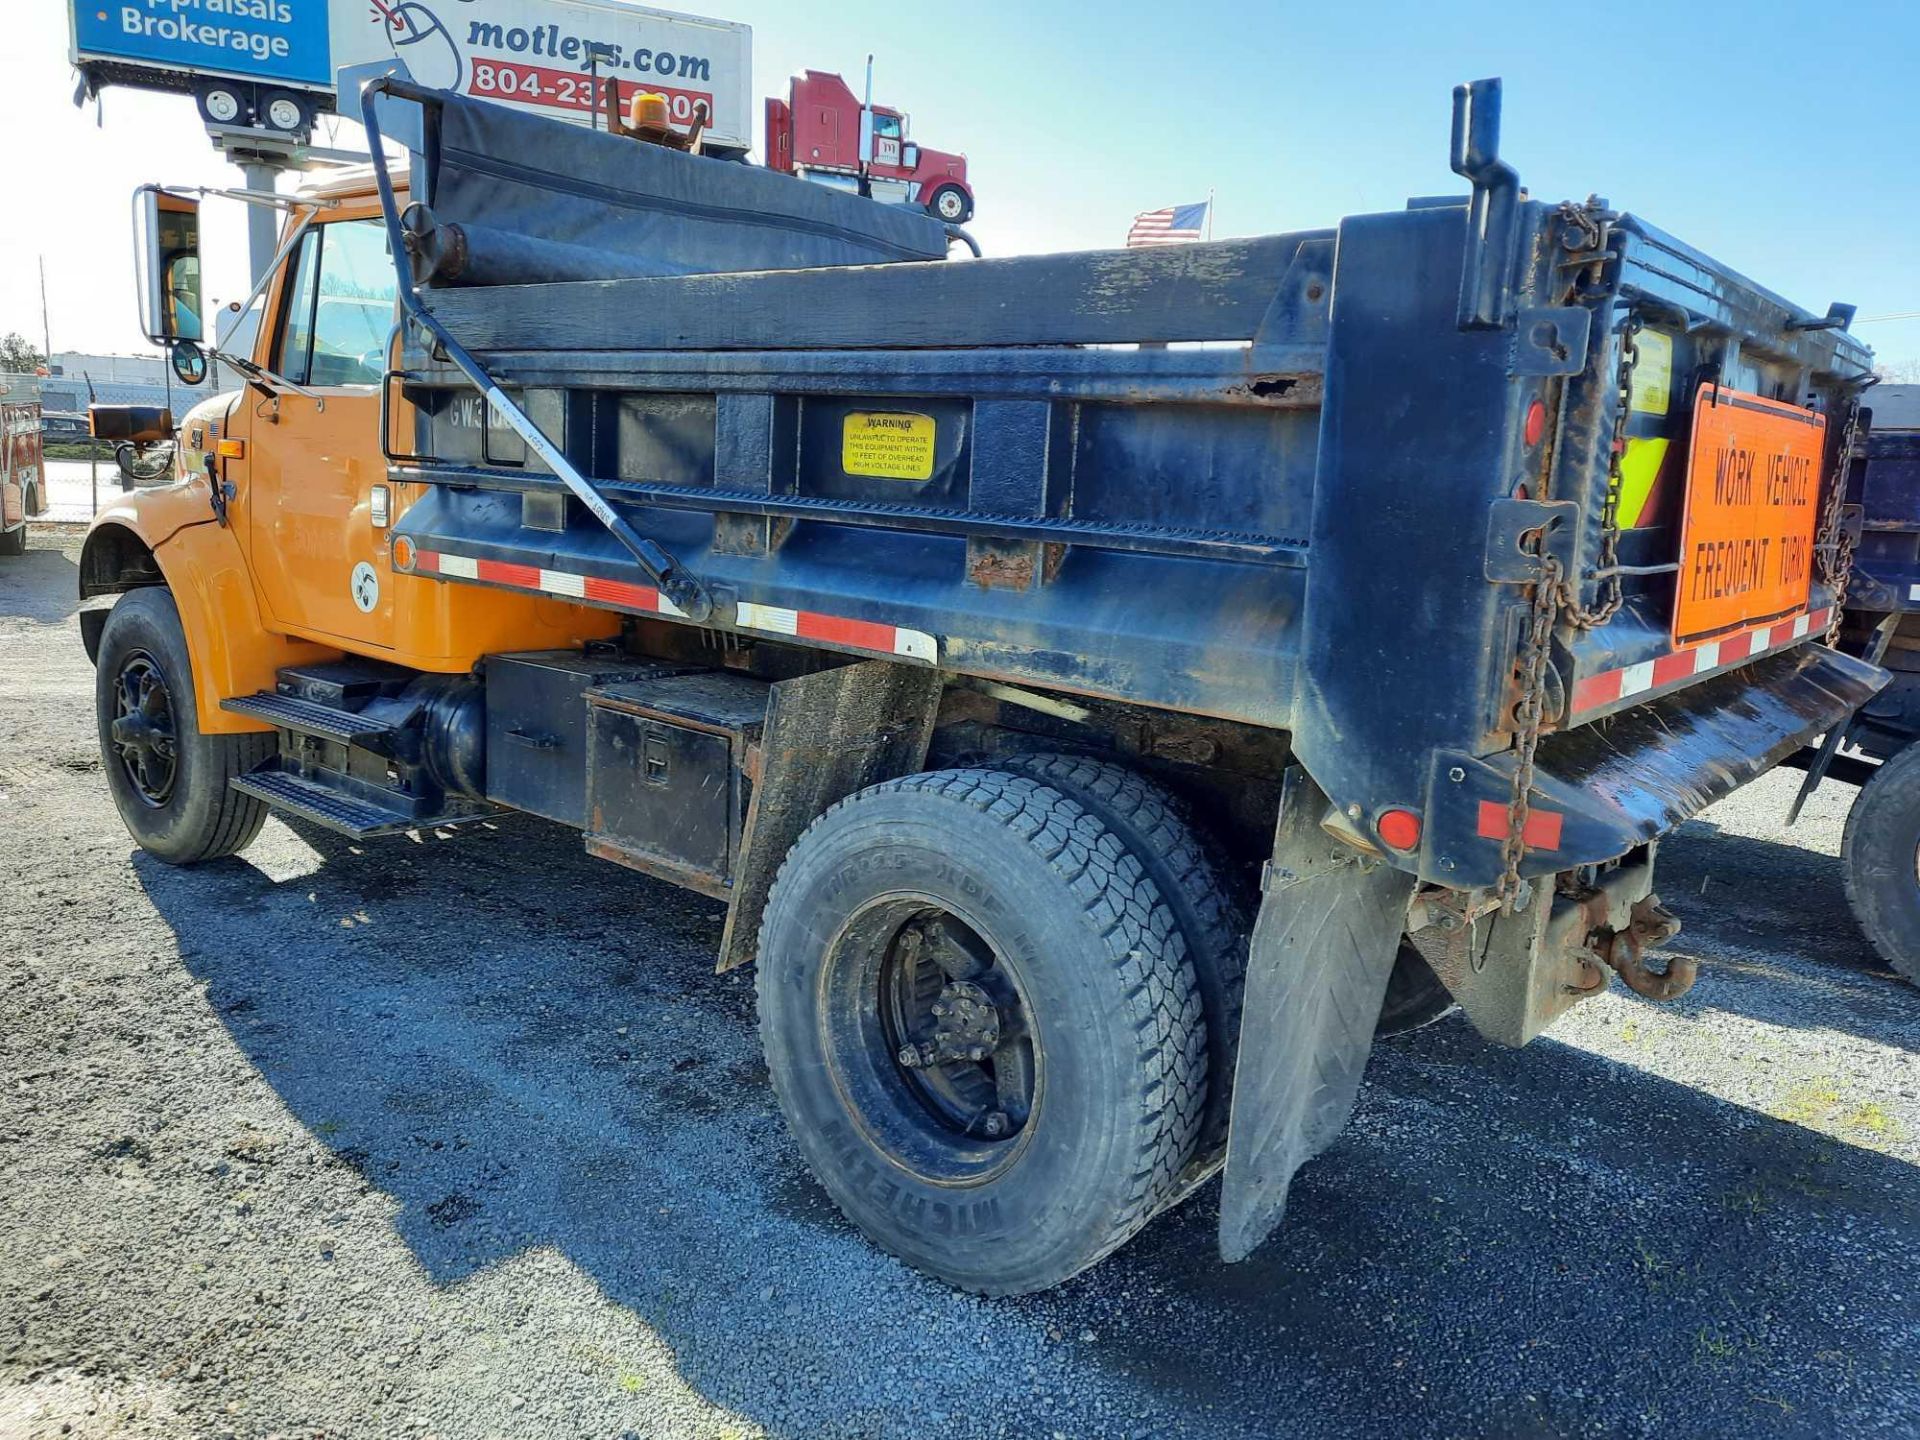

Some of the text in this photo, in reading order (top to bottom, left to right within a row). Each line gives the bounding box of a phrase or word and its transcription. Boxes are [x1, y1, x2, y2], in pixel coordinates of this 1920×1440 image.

[121, 7, 290, 61] Brokerage
[868, 418, 911, 429] WARNING
[897, 436, 928, 444] OPERATE
[849, 442, 863, 450] THIS
[865, 444, 903, 452] EQUIPMENT
[860, 452, 877, 460] FEET
[877, 453, 887, 461] OF
[888, 454, 924, 463] OVERHEAD
[871, 462, 901, 470] VOLTAGE
[1715, 447, 1810, 506] WORK VEHICLE
[1692, 535, 1807, 602] FREQUENT TURNS
